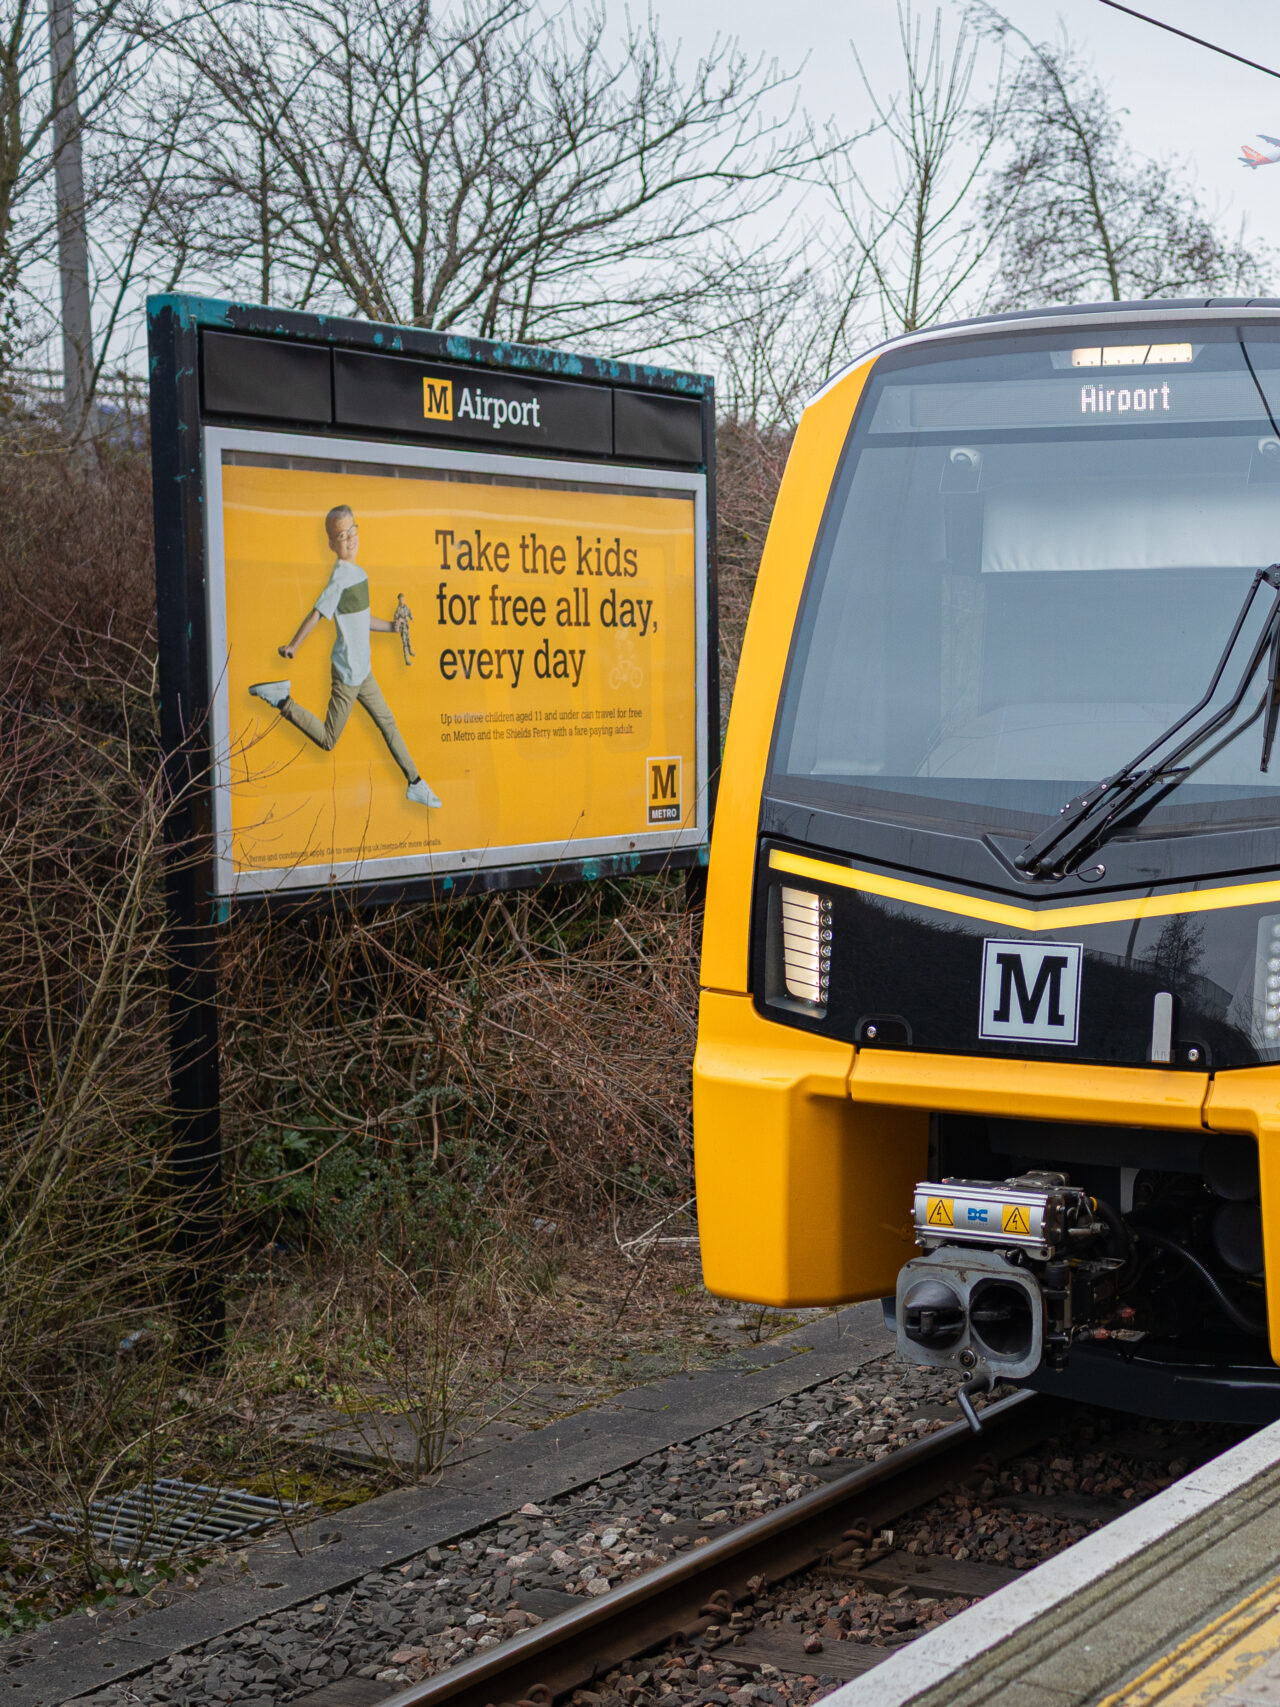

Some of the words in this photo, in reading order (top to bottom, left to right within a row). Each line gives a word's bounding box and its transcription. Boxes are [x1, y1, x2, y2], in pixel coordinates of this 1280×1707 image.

[427, 383, 449, 415] M
[457, 387, 541, 429] Airport
[1081, 382, 1171, 414] Airport
[435, 529, 510, 573] Take
[519, 533, 567, 575] the
[576, 535, 638, 578] kids
[436, 582, 480, 626] for
[489, 584, 546, 627] free
[556, 587, 591, 627] all
[600, 588, 658, 637] day,
[439, 648, 525, 689] every
[534, 638, 586, 687] day
[440, 713, 453, 726] Up
[454, 713, 462, 724] to
[463, 712, 484, 724] three
[485, 711, 514, 723] children
[516, 711, 533, 723] aged
[534, 711, 543, 721] 11
[544, 709, 558, 721] and
[559, 709, 580, 720] under
[581, 711, 594, 720] can
[595, 708, 616, 719] travel
[617, 707, 627, 718] for
[628, 707, 643, 718] free
[440, 732, 452, 742] on
[453, 730, 476, 742] Metro
[477, 729, 492, 741] and
[492, 729, 505, 740] the
[505, 727, 532, 739] Shields
[533, 727, 551, 740] Ferry
[552, 726, 567, 737] with
[568, 728, 574, 737] a
[574, 725, 588, 736] fare
[589, 724, 613, 738] paying
[651, 764, 677, 800] M
[651, 808, 678, 819] METRO
[993, 952, 1068, 1026] M
